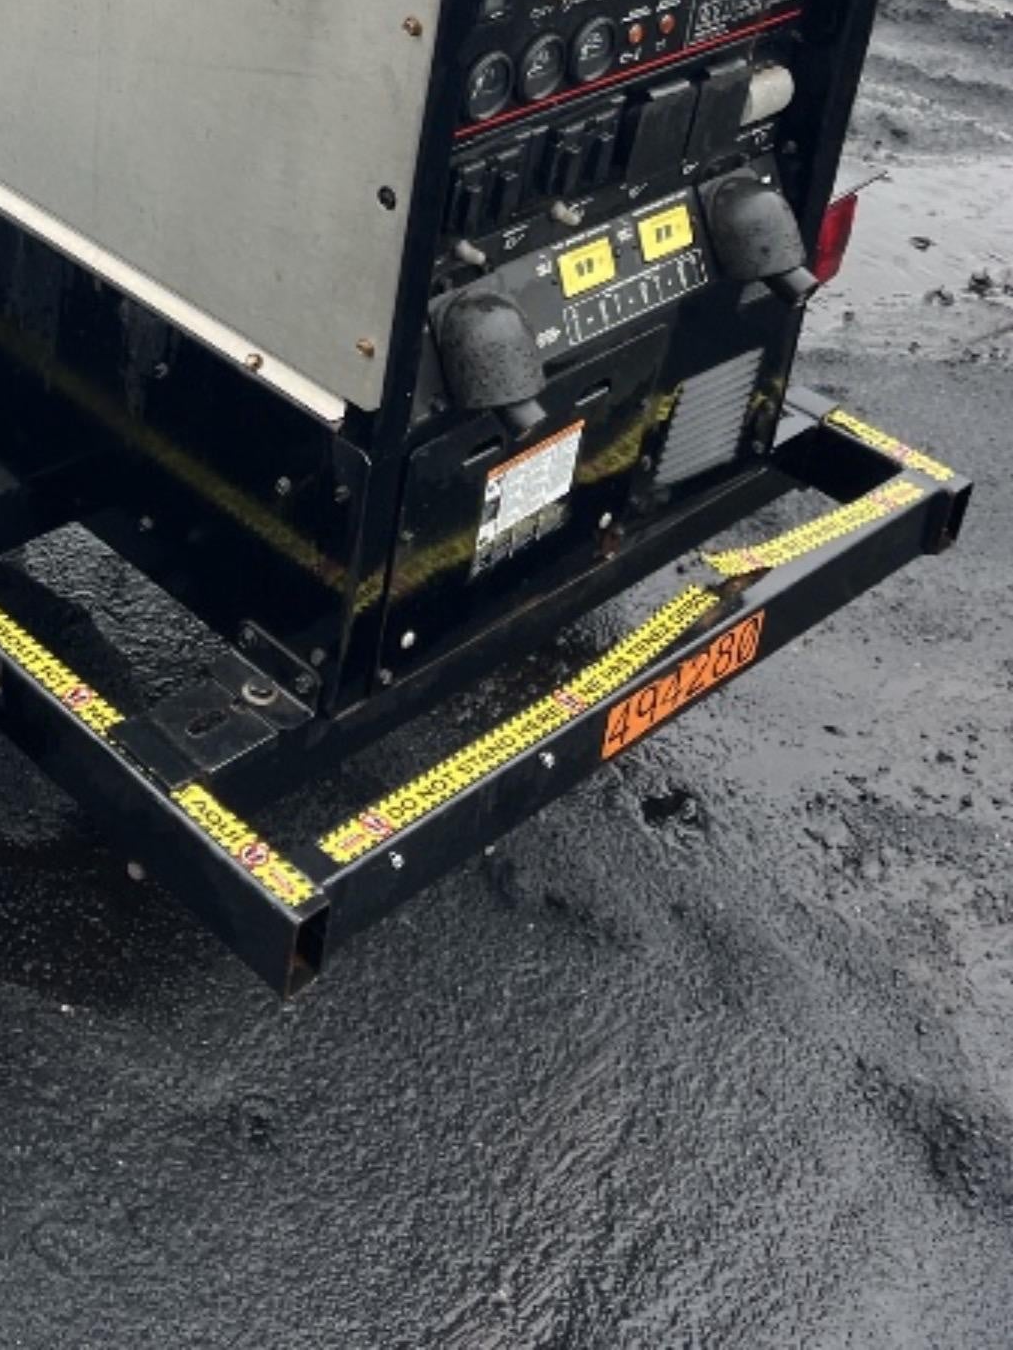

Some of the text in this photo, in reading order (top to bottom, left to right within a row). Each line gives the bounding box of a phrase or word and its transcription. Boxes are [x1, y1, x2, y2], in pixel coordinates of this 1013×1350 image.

[606, 615, 762, 746] 494280
[386, 796, 418, 820] DO
[418, 771, 460, 801] NOT
[457, 733, 517, 776] STAND
[515, 702, 565, 738] HERE
